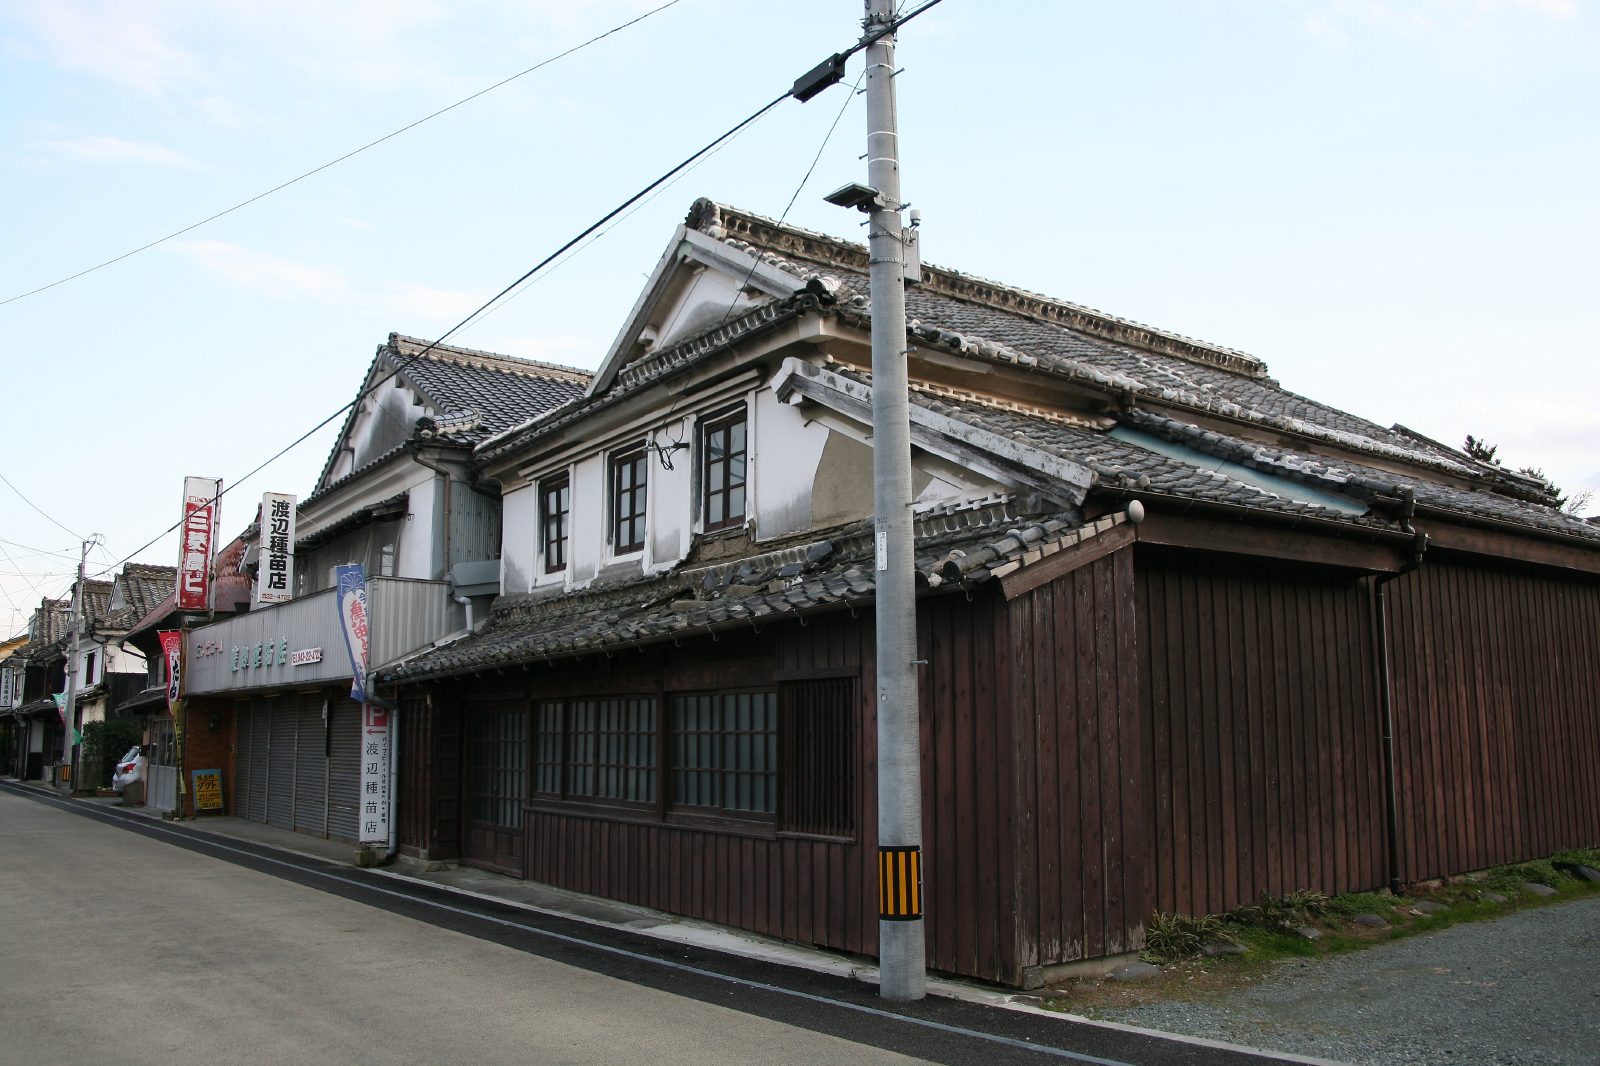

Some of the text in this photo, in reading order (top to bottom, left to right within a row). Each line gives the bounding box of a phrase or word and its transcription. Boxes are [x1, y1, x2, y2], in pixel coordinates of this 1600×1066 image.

[268, 499, 290, 590] 渡辺種苗店
[369, 705, 385, 726] P
[365, 742, 379, 833] 渡辺種苗店
